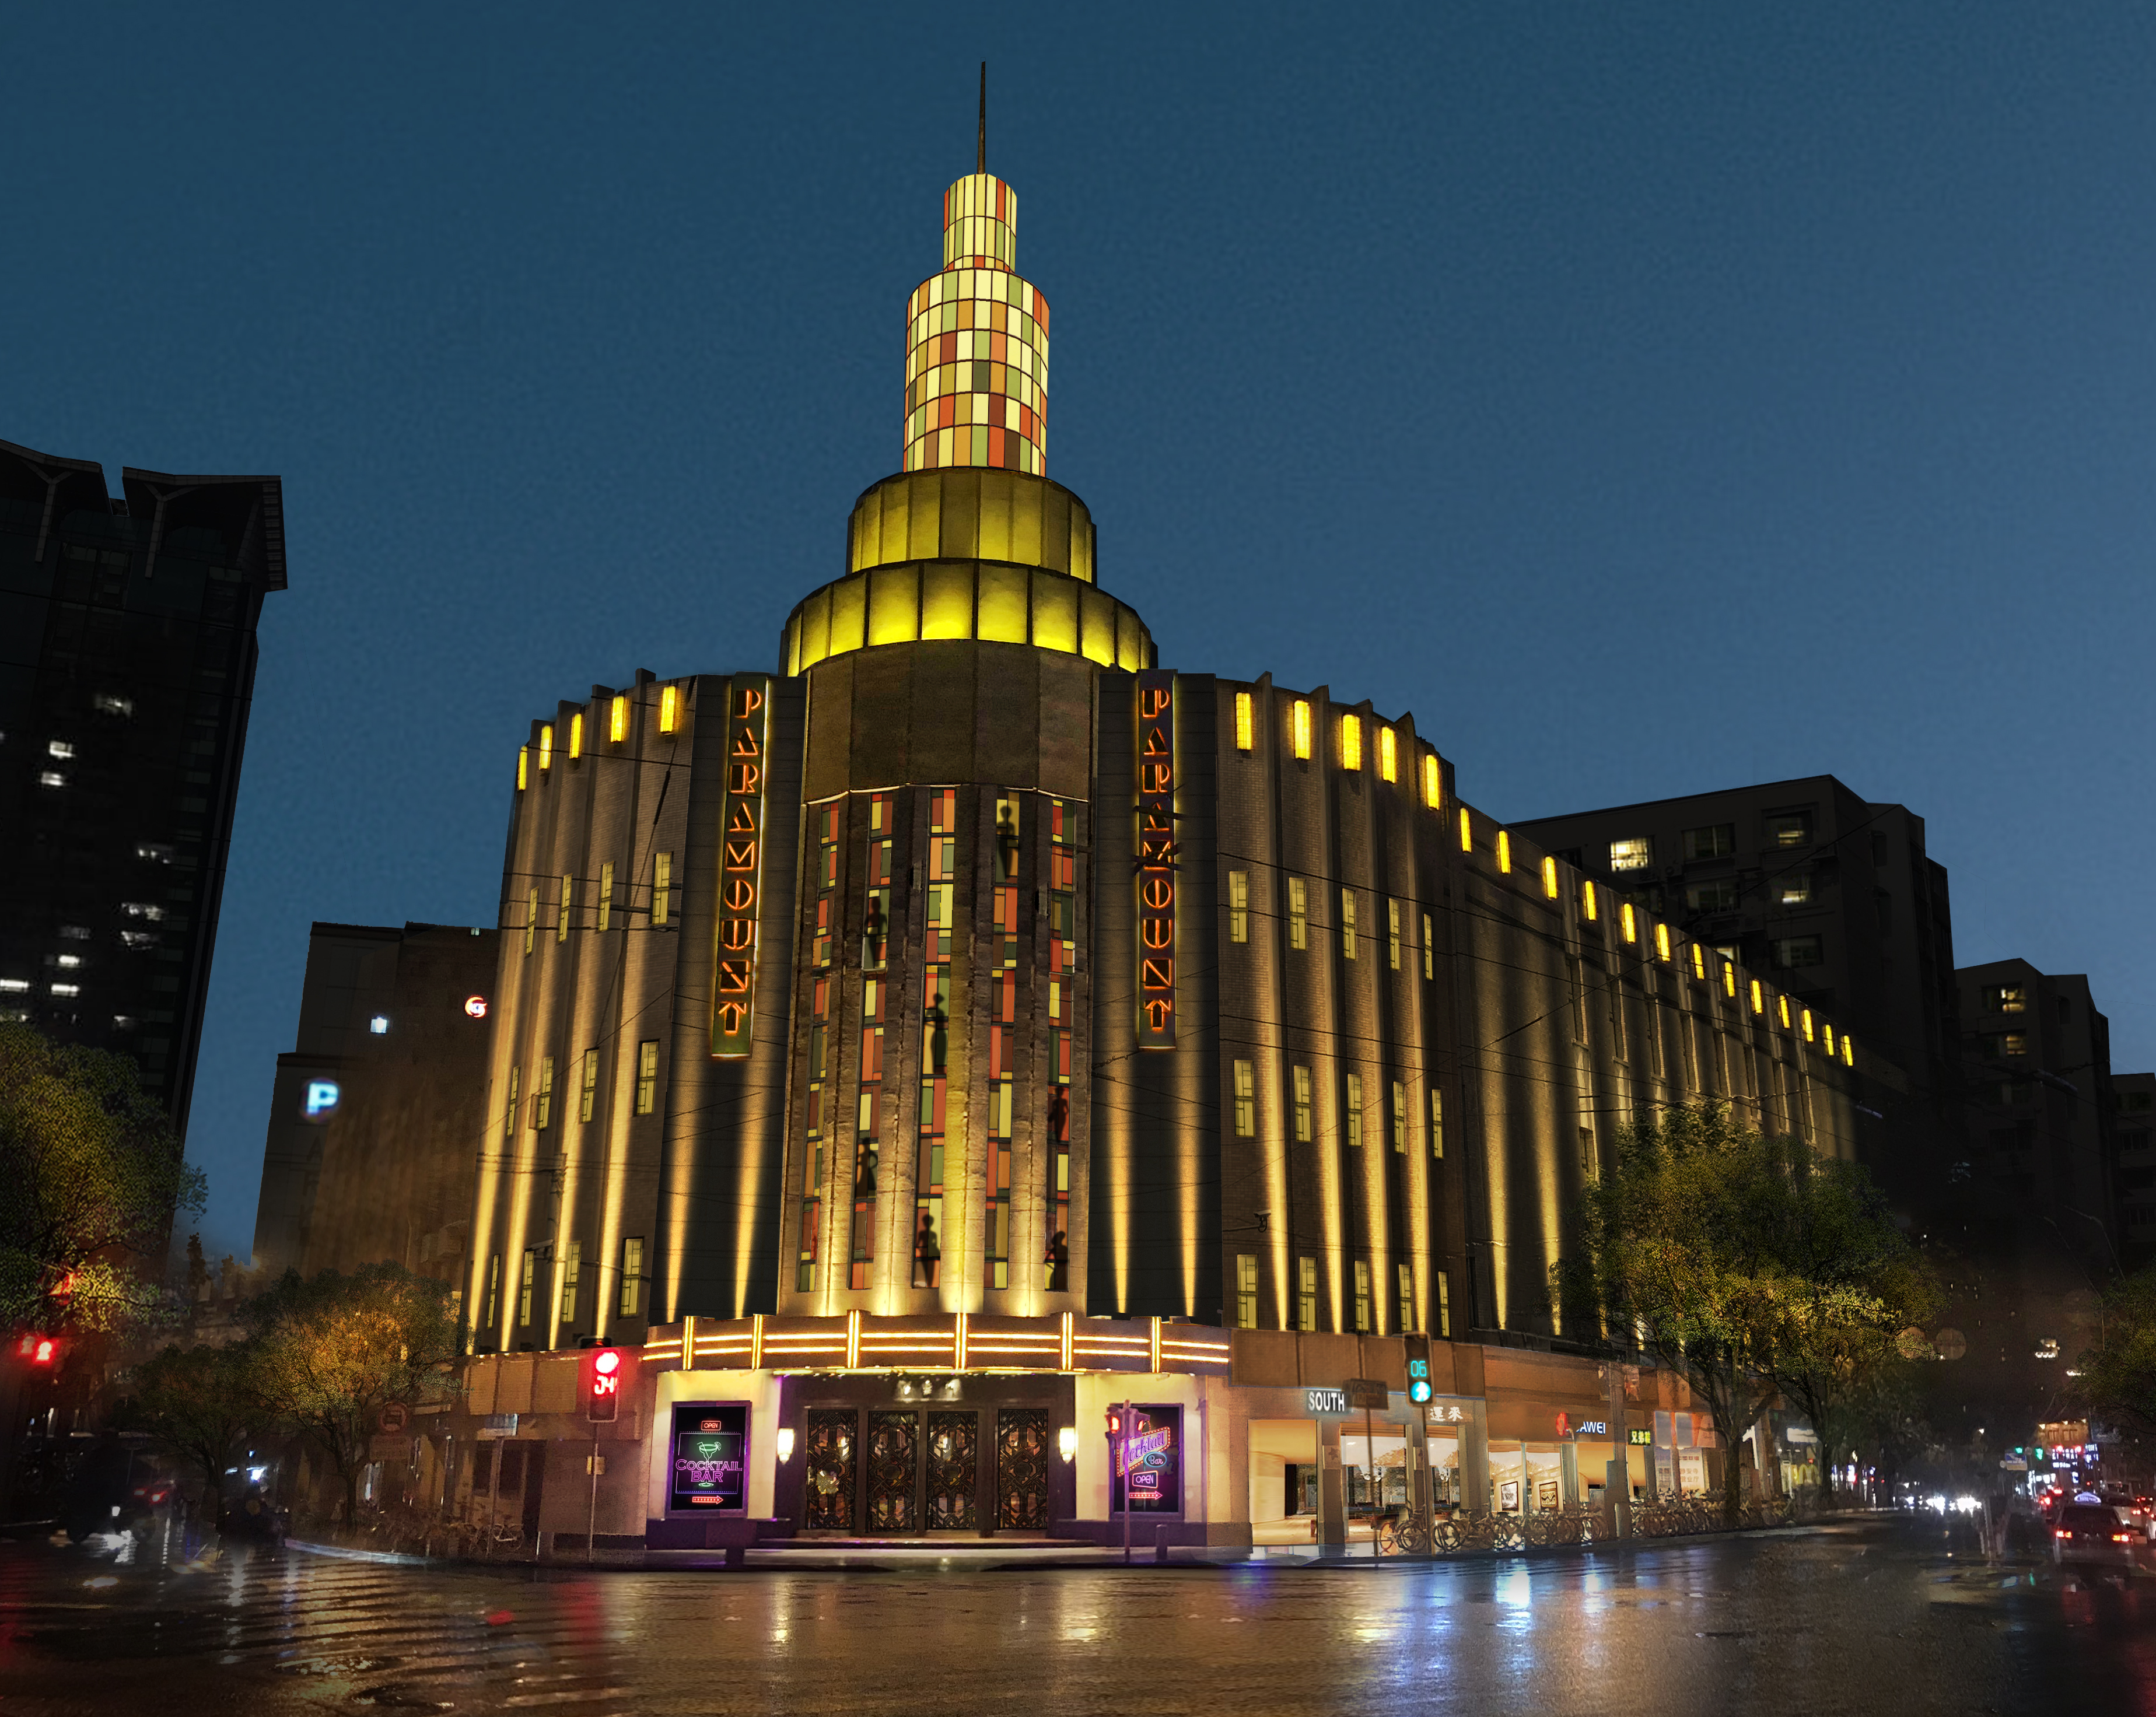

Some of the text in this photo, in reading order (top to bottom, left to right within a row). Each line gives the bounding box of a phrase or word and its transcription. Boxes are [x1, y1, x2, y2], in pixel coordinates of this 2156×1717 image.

[718, 689, 761, 1036] PARAMOUNT
[1142, 689, 1172, 1031] PARAMOUNT
[307, 1082, 338, 1114] P
[1410, 1360, 1427, 1377] 06
[1308, 1391, 1345, 1412] SOUTH
[1148, 1455, 1164, 1465] Bar
[691, 1470, 723, 1483] BAR
[1135, 1474, 1154, 1484] OPEN
